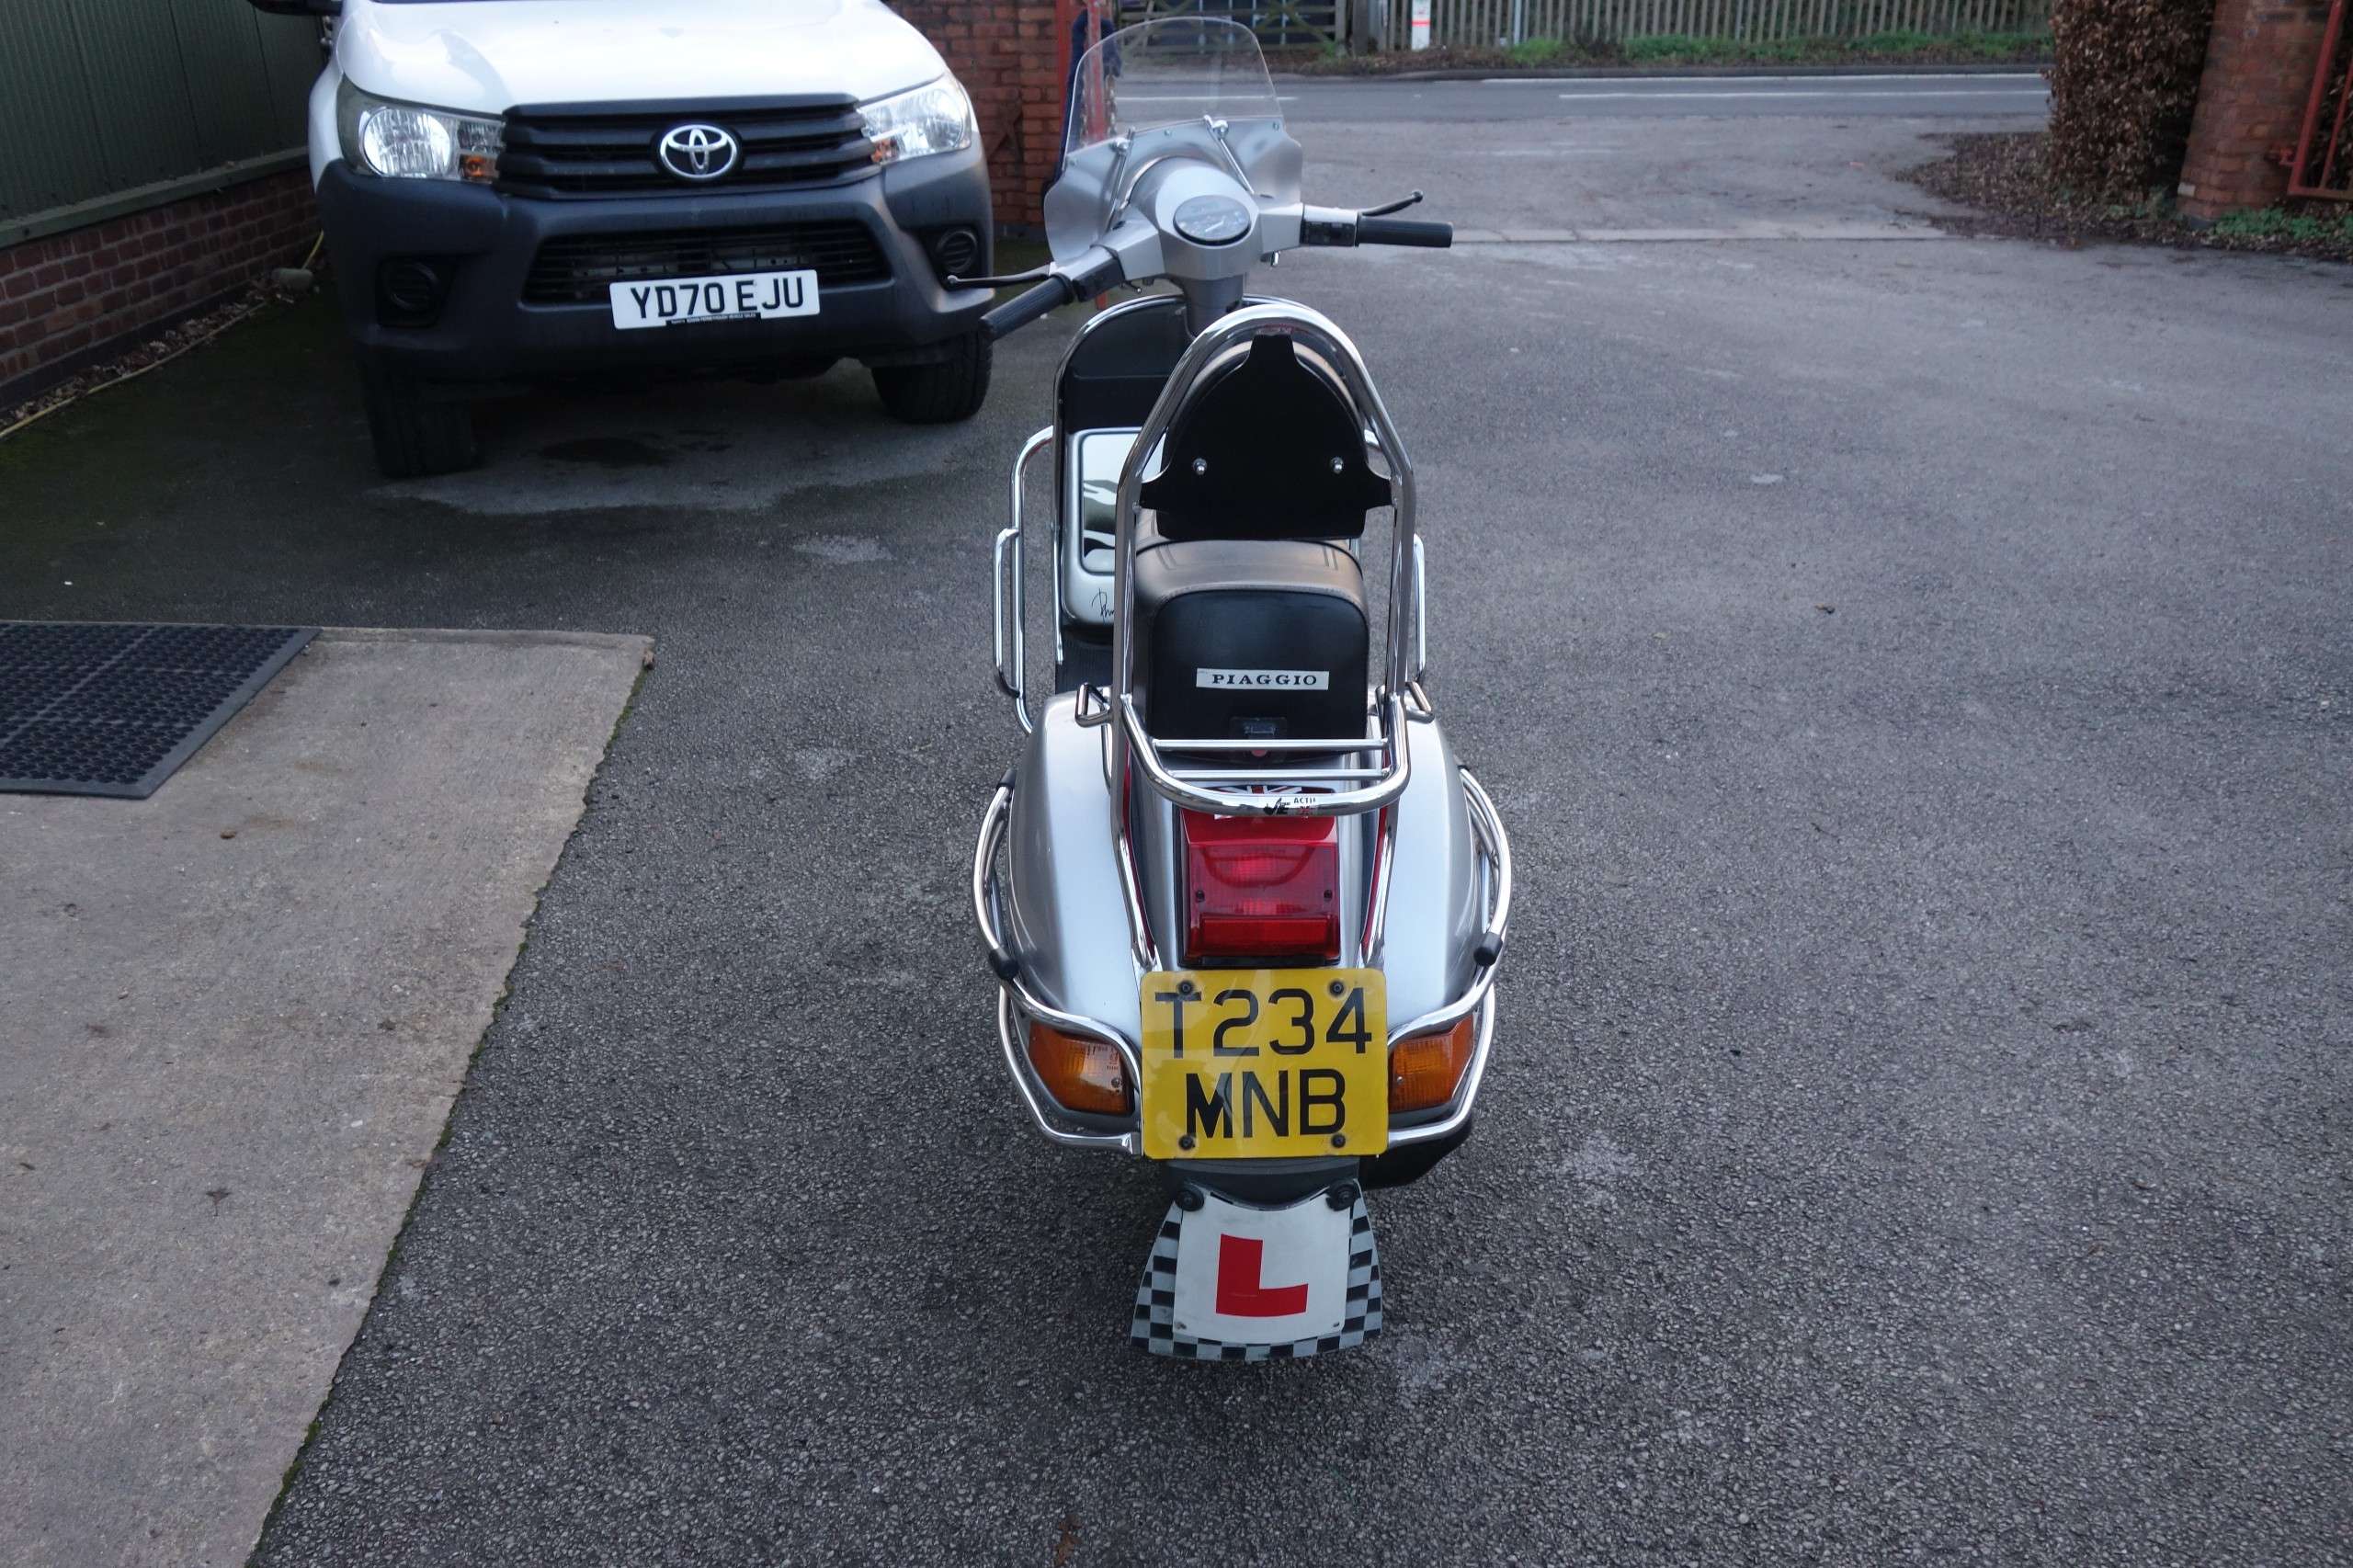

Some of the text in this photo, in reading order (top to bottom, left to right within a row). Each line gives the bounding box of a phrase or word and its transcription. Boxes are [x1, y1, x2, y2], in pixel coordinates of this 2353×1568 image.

[631, 277, 804, 319] YD70 EJU
[1211, 674, 1317, 686] PIAGGIO
[1154, 987, 1372, 1059] T234
[1185, 1068, 1347, 1139] MNB
[1216, 1233, 1309, 1317] L
